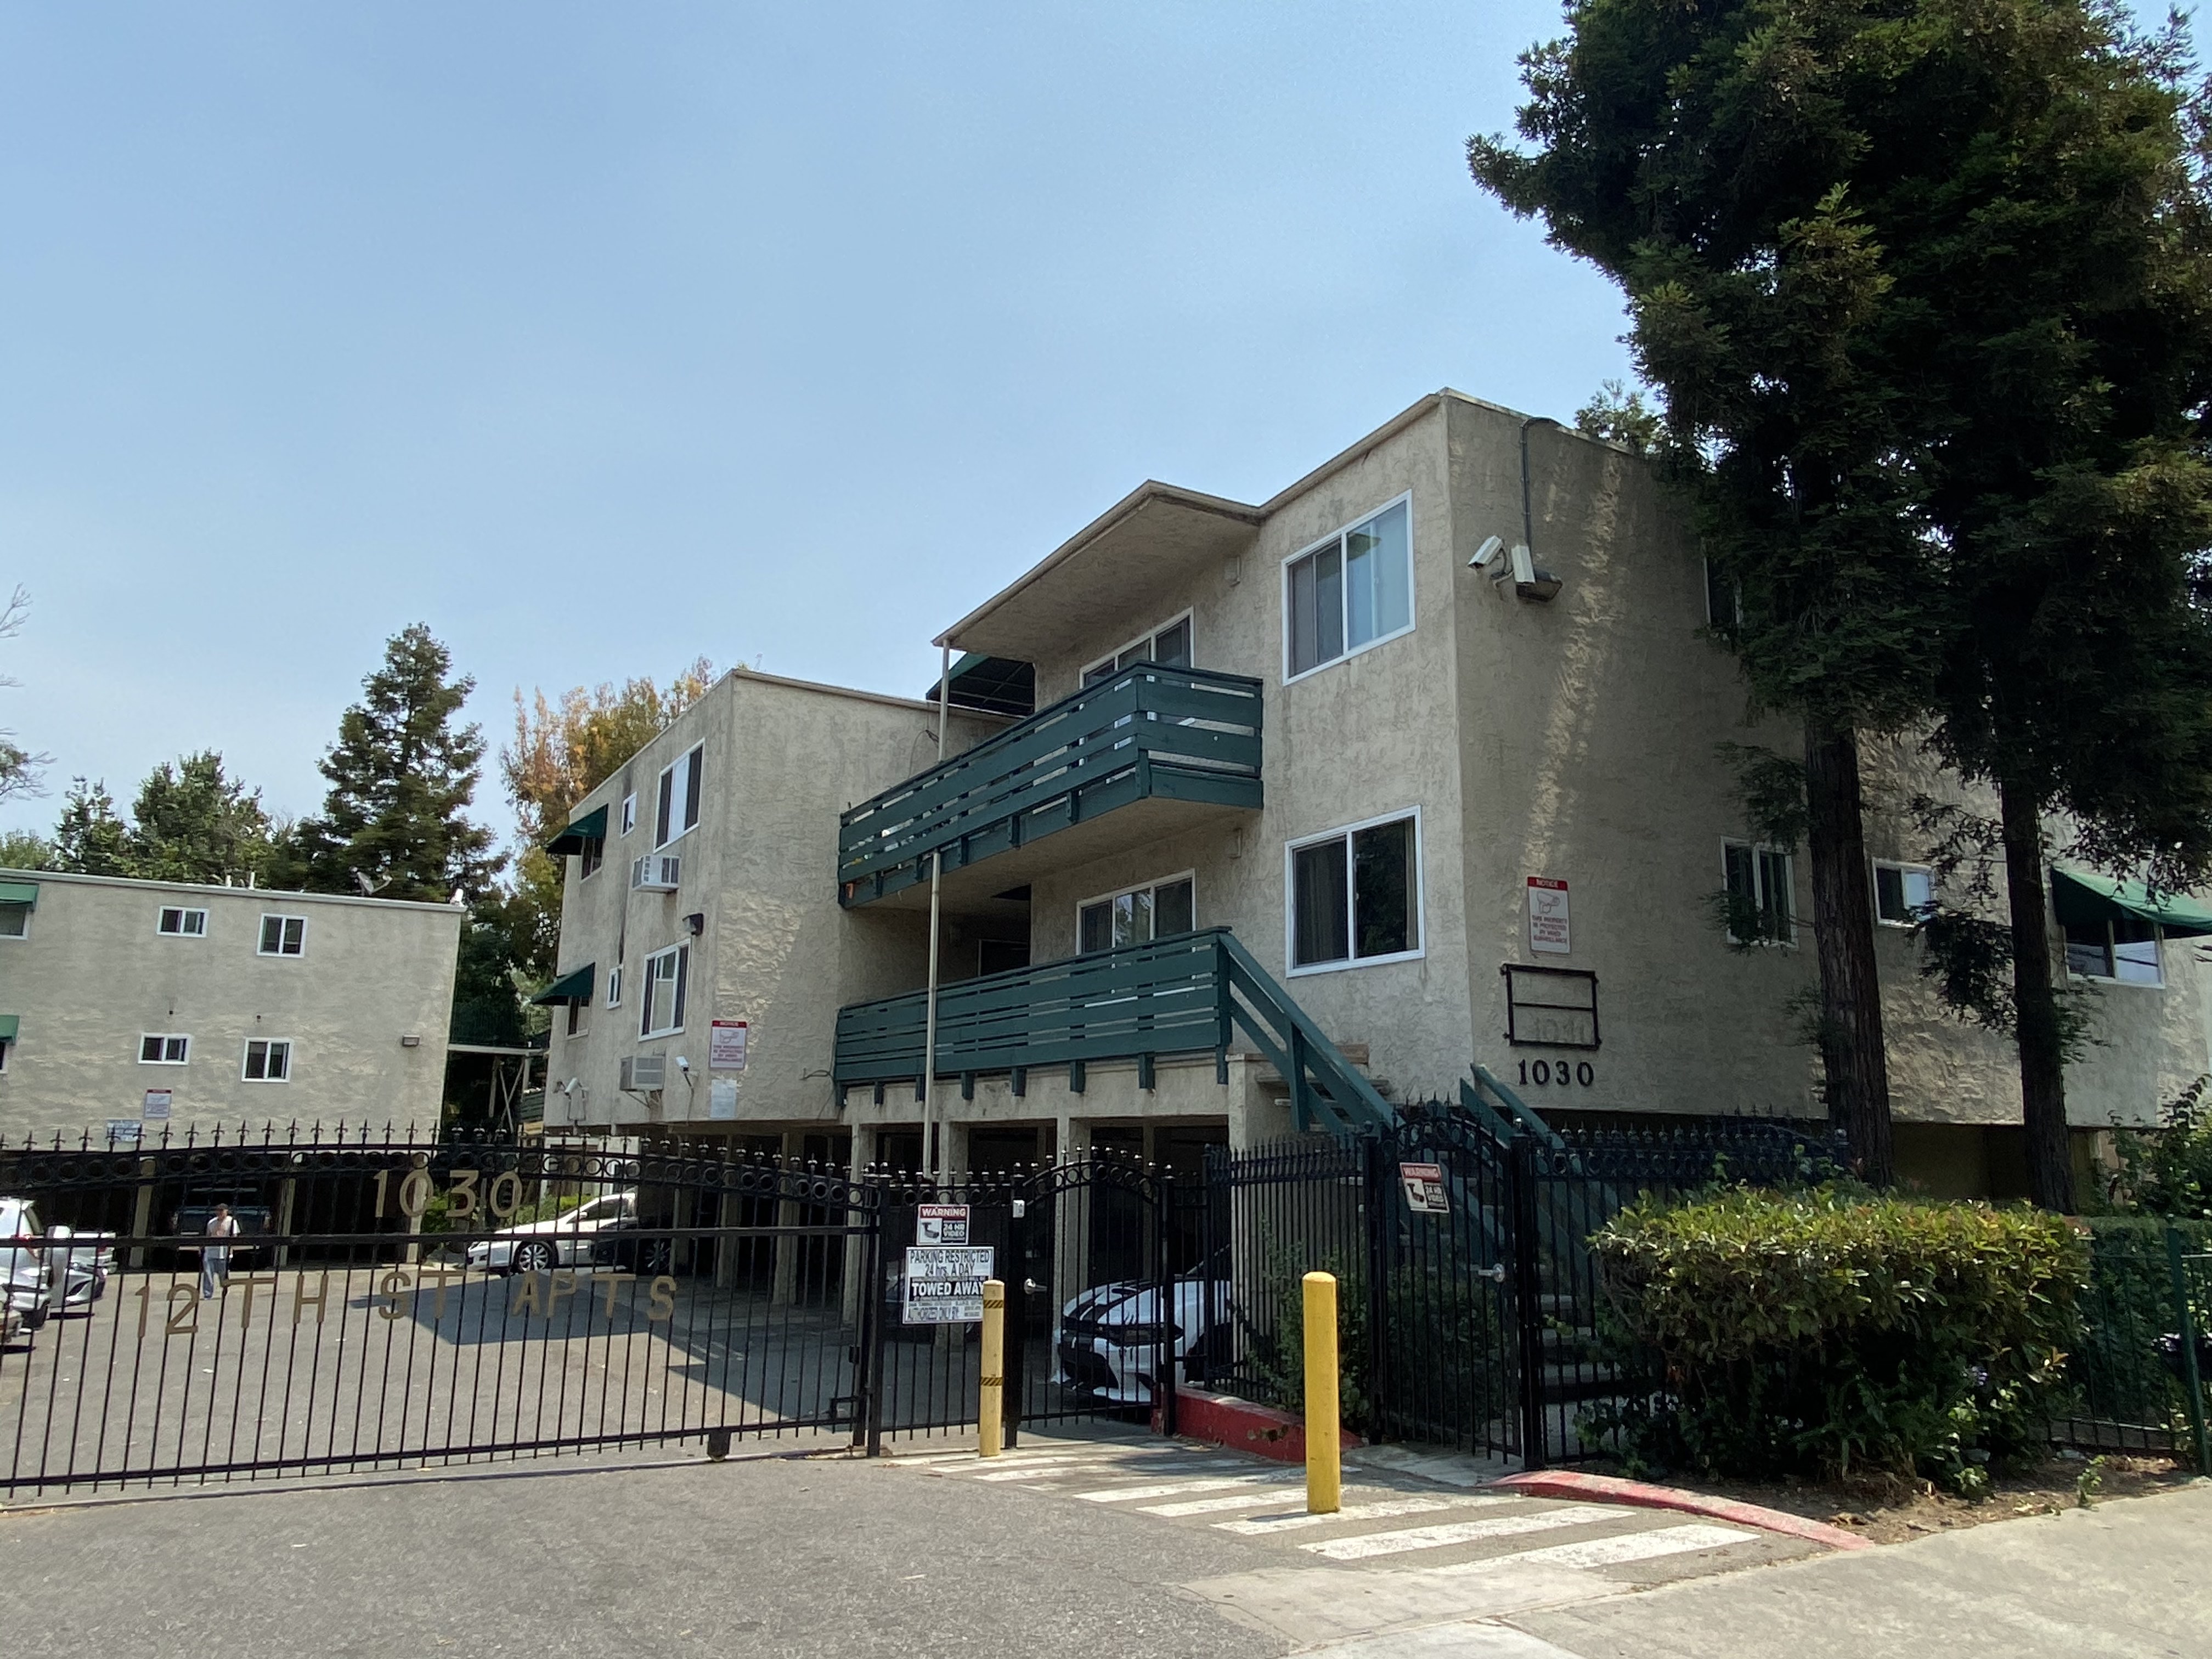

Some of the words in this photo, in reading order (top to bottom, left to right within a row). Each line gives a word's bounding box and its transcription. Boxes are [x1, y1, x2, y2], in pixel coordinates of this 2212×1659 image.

[1518, 1059, 1594, 1087] 1030
[373, 1169, 523, 1218] 1030
[922, 1207, 966, 1217] WARNING
[943, 1223, 953, 1231] 24
[910, 1250, 944, 1263] PARKING
[945, 1249, 990, 1263] RESTRICTED
[925, 1263, 933, 1277] 24
[951, 1263, 957, 1276] A
[959, 1263, 975, 1276] DAY
[911, 1282, 952, 1296] TOWED
[135, 1274, 329, 1339] 12TH
[379, 1270, 465, 1319] ST
[512, 1271, 677, 1321] APTS
